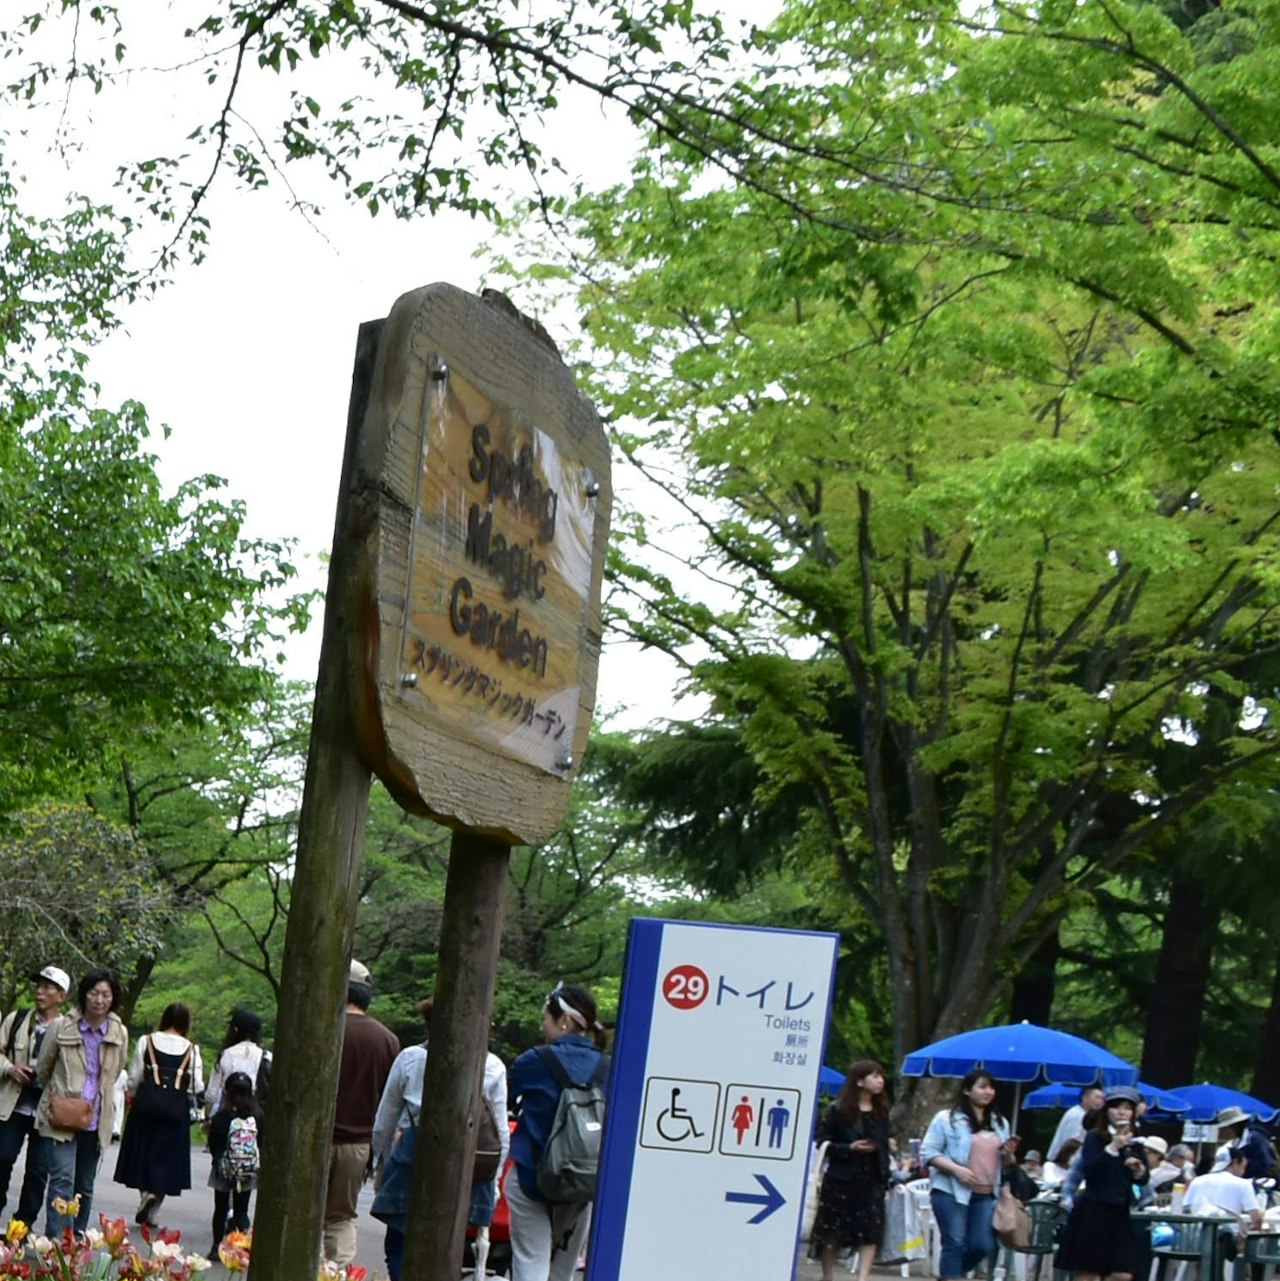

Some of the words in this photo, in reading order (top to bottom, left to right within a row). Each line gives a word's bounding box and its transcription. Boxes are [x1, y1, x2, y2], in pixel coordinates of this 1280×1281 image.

[469, 424, 558, 543] Spring
[466, 502, 547, 601] Magic
[450, 577, 548, 679] Garden
[667, 973, 705, 1001] 29
[716, 975, 815, 1011] トイレ
[764, 1014, 811, 1032] Toilets
[771, 1051, 808, 1066] 화장실
